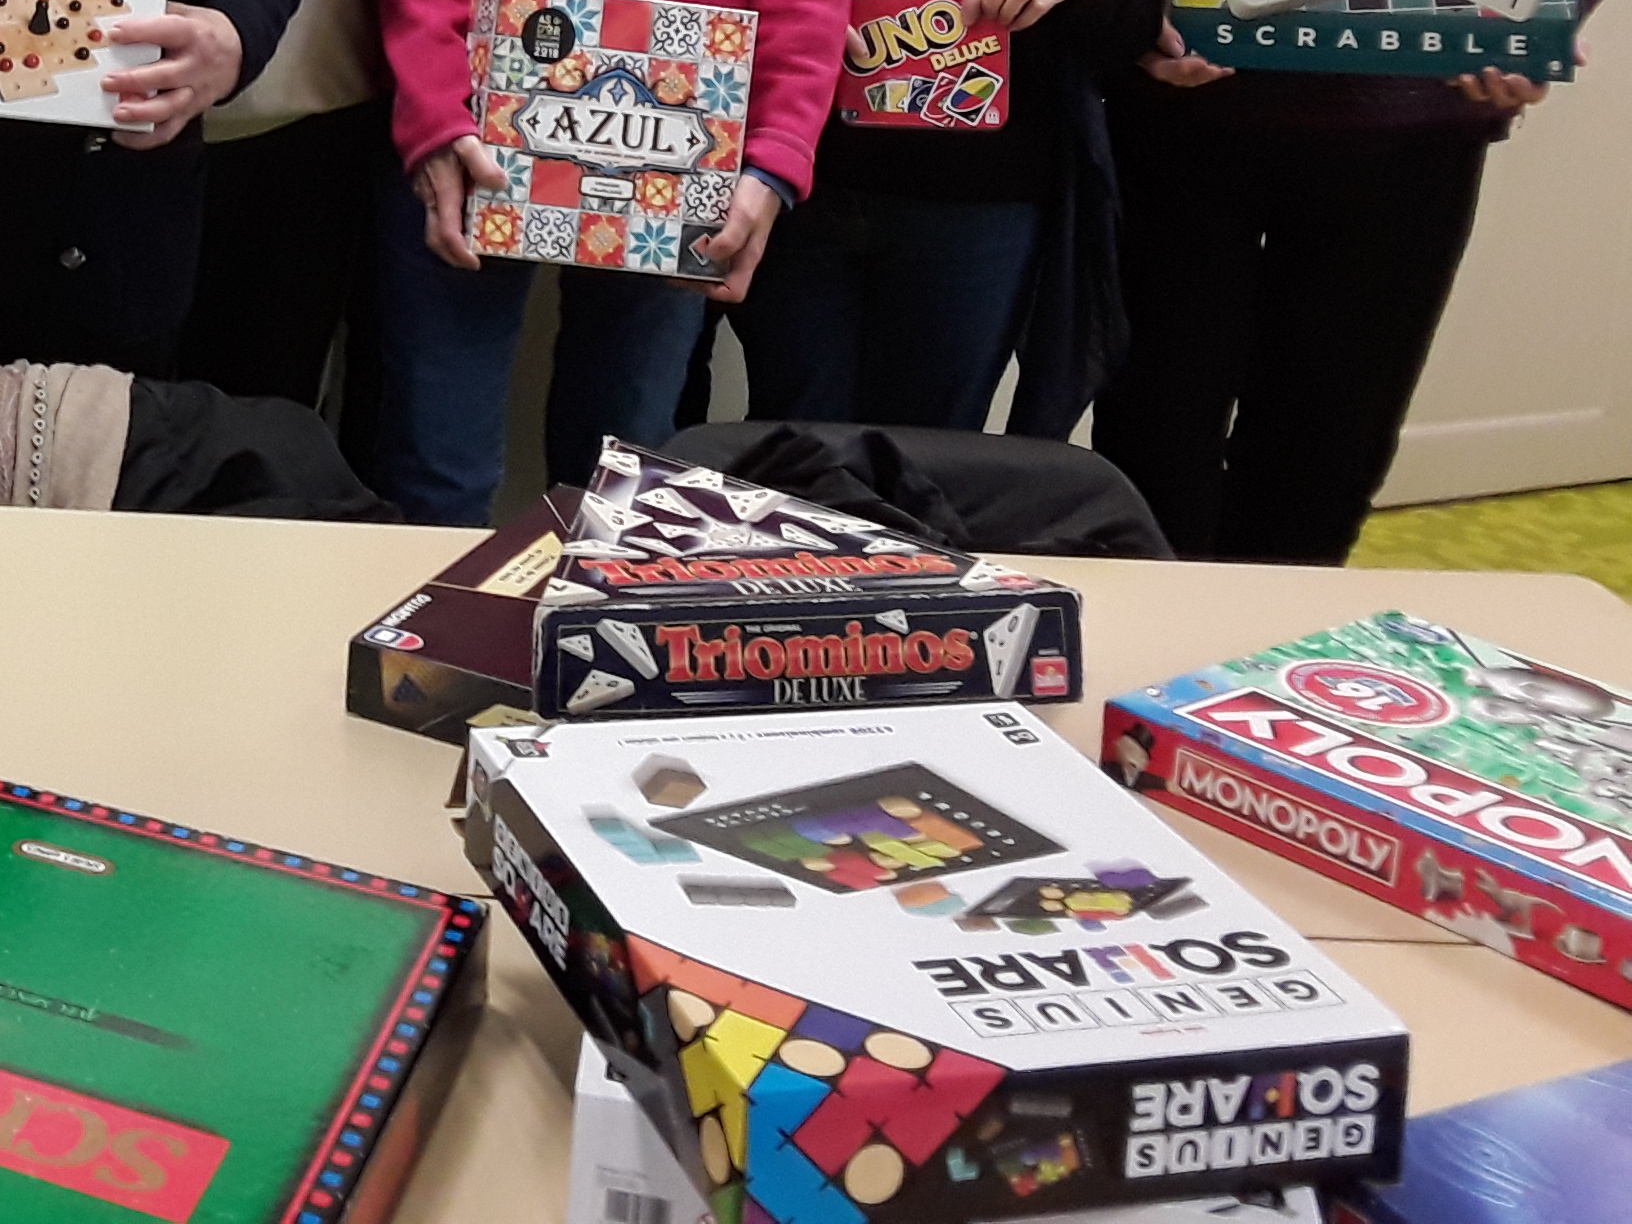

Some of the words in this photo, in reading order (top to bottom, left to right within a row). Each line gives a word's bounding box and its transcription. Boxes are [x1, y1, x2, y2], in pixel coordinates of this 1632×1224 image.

[849, 0, 967, 71] UNO
[930, 34, 1002, 72] DELUXE
[1215, 24, 1529, 57] SCRABBLE
[547, 105, 676, 153] AZUL
[579, 551, 959, 586] Triominos
[656, 620, 976, 683] Triominos
[773, 679, 805, 706] DE
[808, 676, 867, 704] LUXE
[1178, 760, 1393, 875] MONOPOLY
[974, 978, 1325, 1033] GENIUS
[1129, 1119, 1372, 1174] GENIUS
